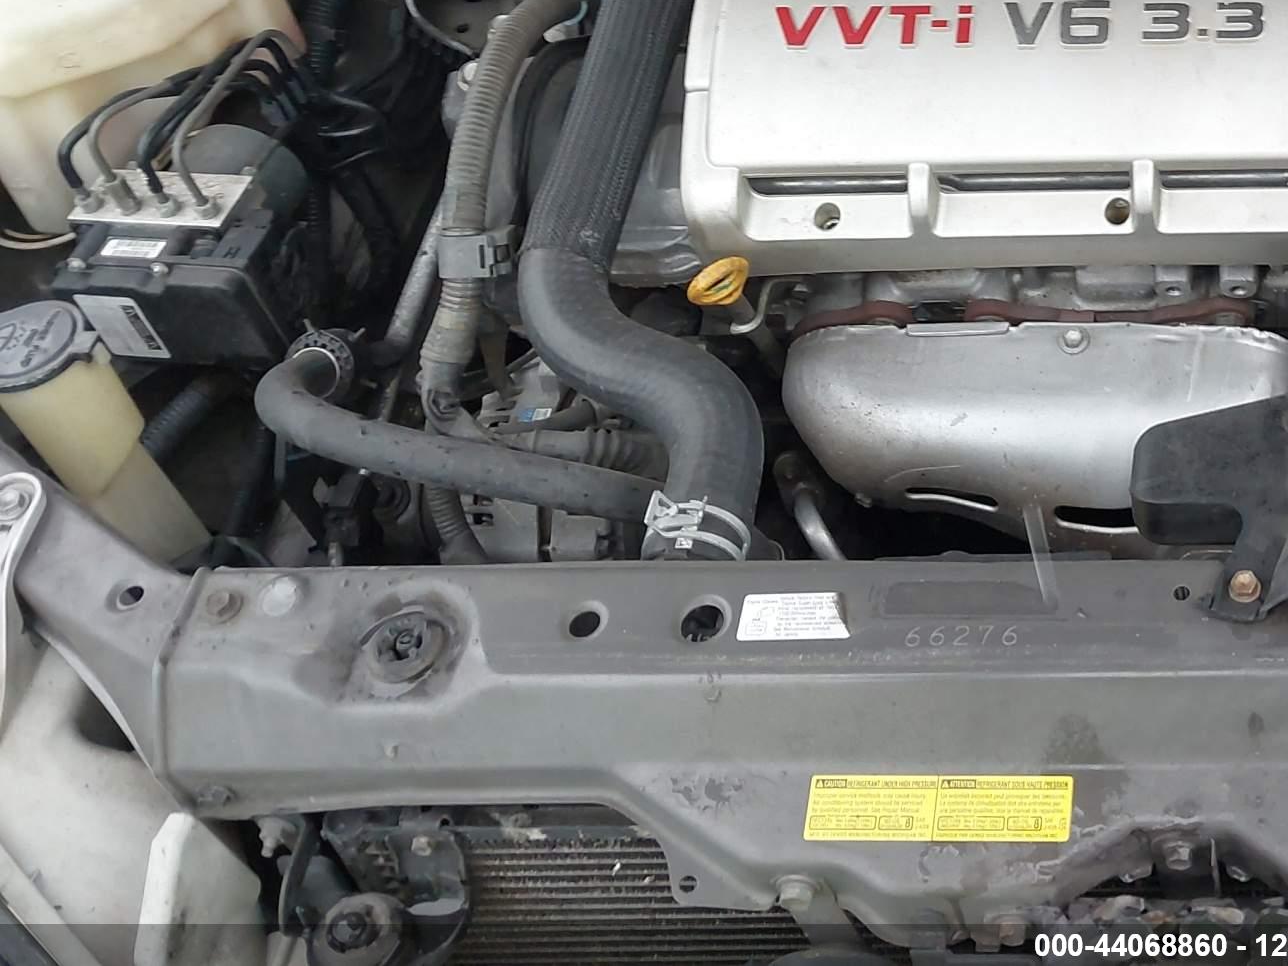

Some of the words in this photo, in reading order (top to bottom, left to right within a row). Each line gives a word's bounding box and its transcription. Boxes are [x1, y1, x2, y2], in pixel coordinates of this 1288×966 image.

[775, 3, 973, 48] VVT-i
[1004, 0, 1111, 46] V6
[1141, 0, 1265, 42] 3.3
[904, 625, 1018, 647] 66276
